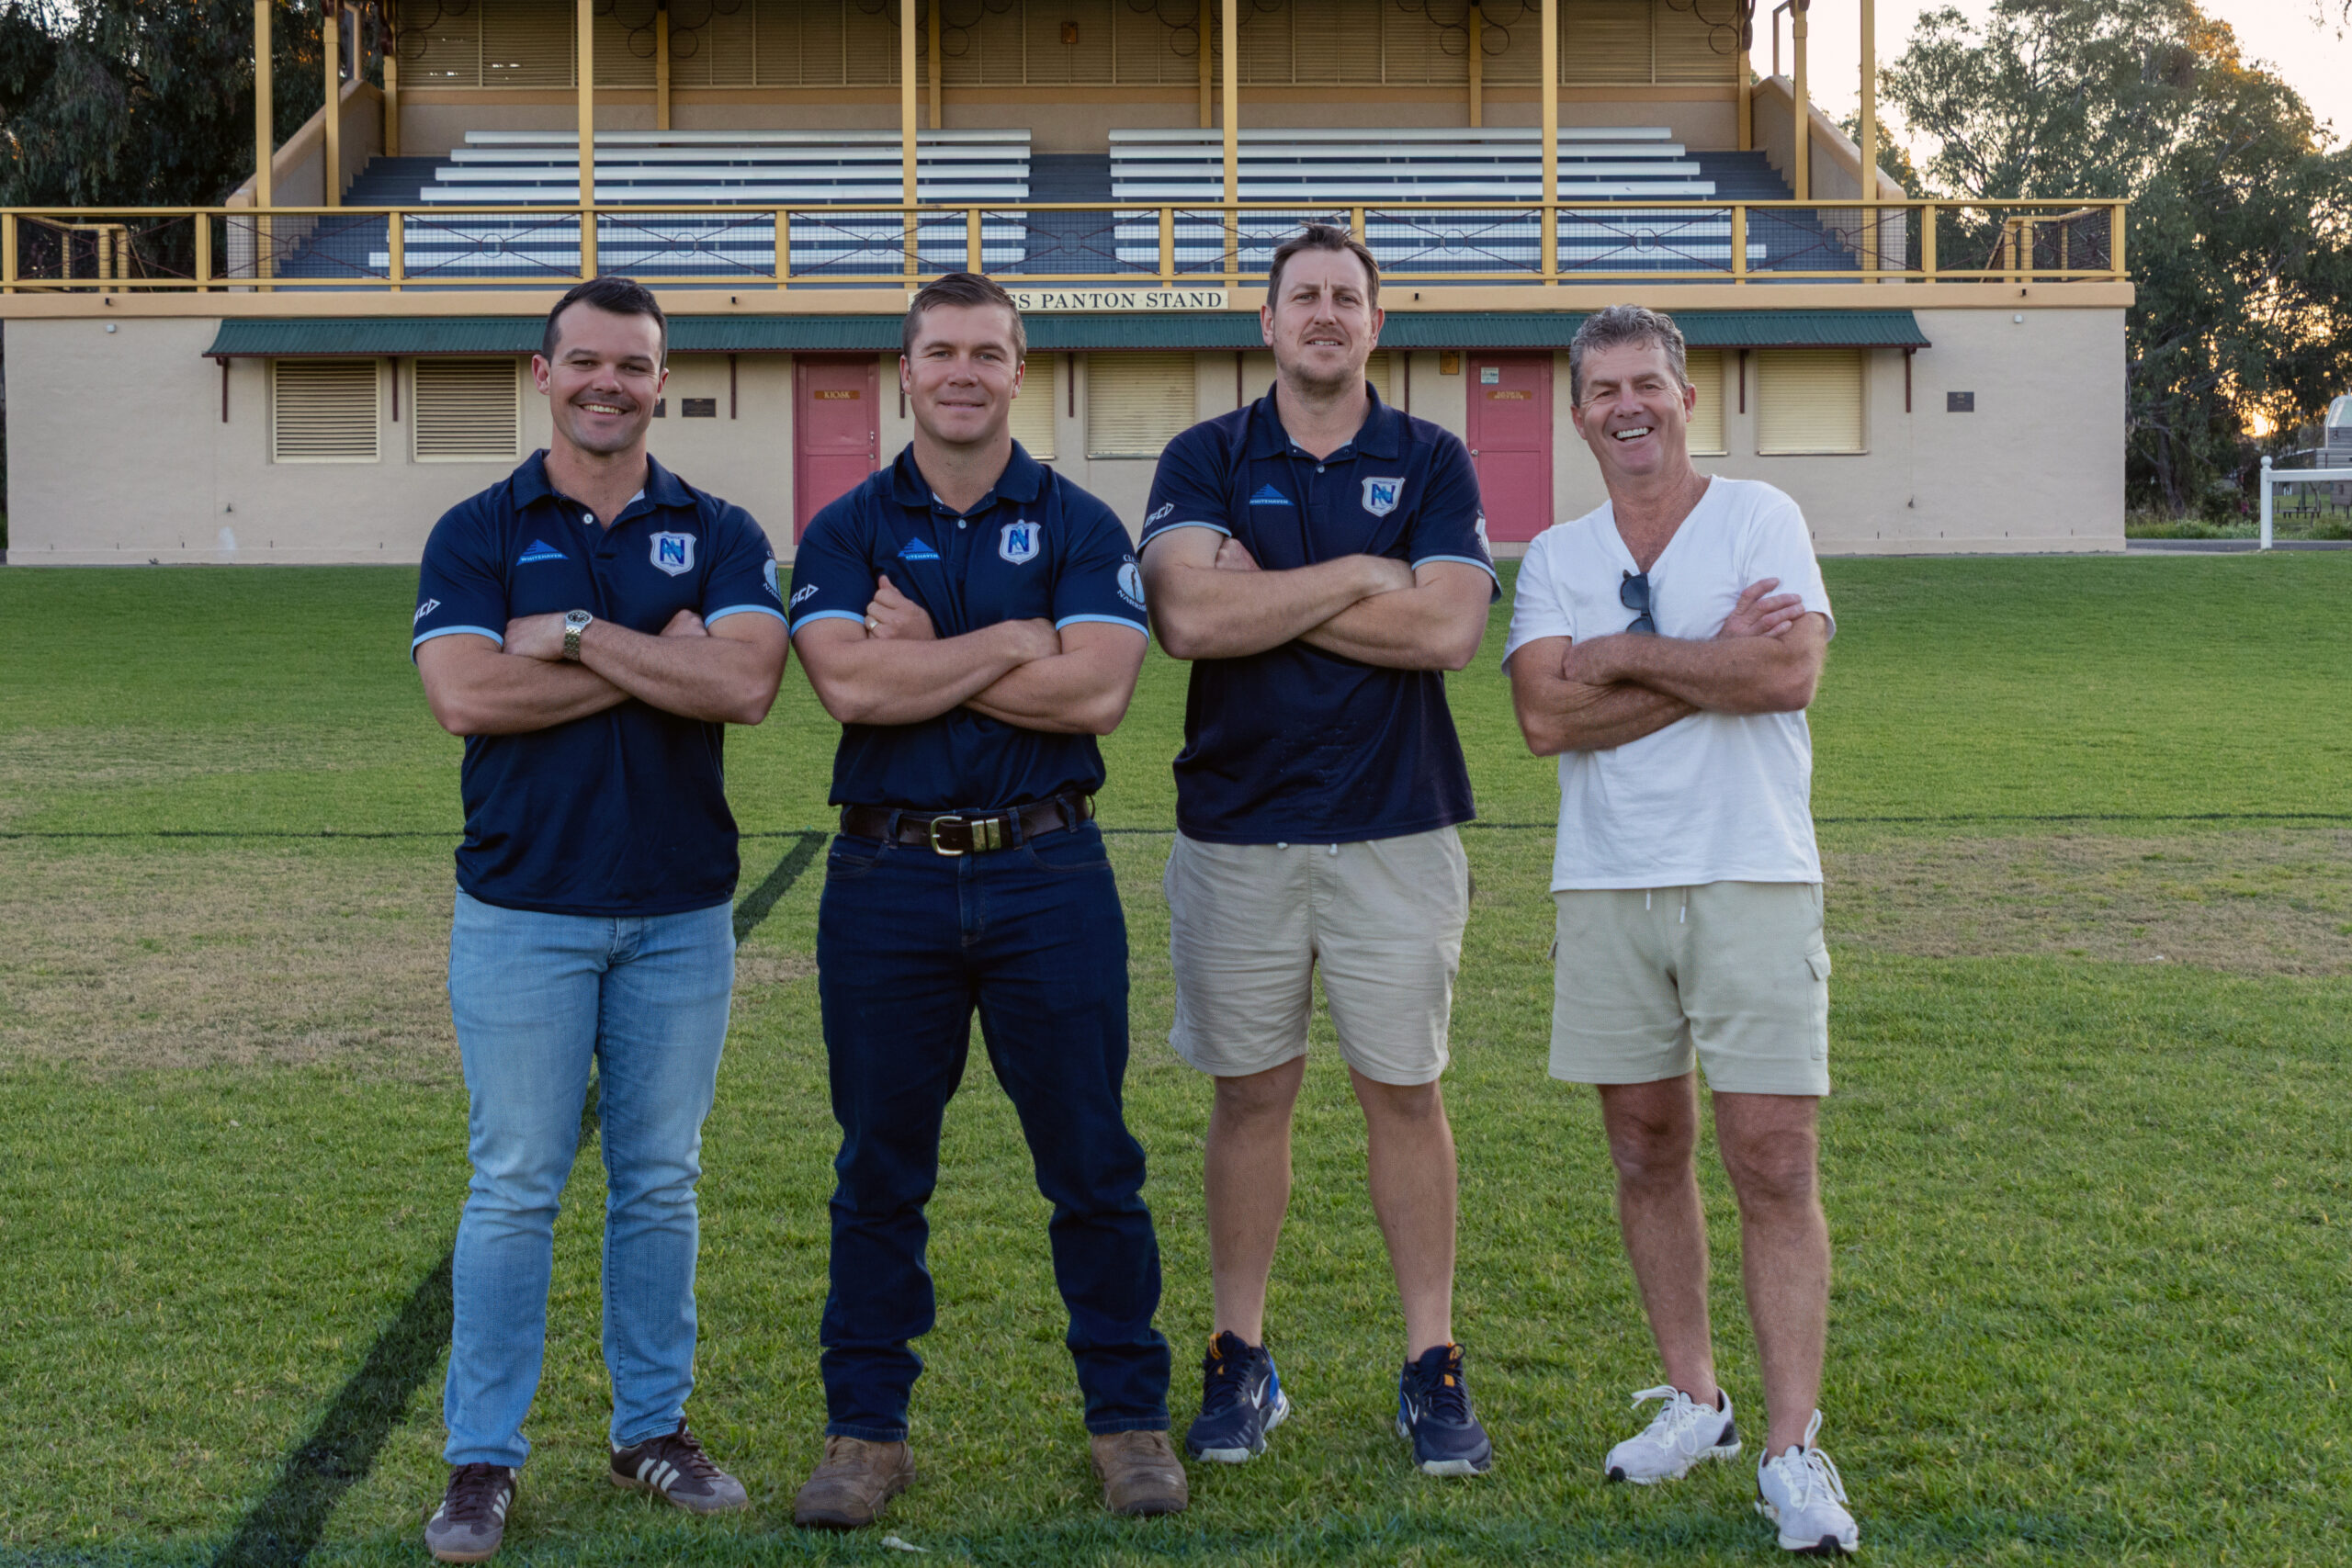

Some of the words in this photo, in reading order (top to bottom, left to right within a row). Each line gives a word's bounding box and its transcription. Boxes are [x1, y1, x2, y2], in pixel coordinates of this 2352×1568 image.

[1041, 292, 1136, 309] PANTON
[1146, 291, 1222, 308] STAND
[824, 390, 851, 399] KIOSK
[520, 553, 563, 561] WHITEHAVEN
